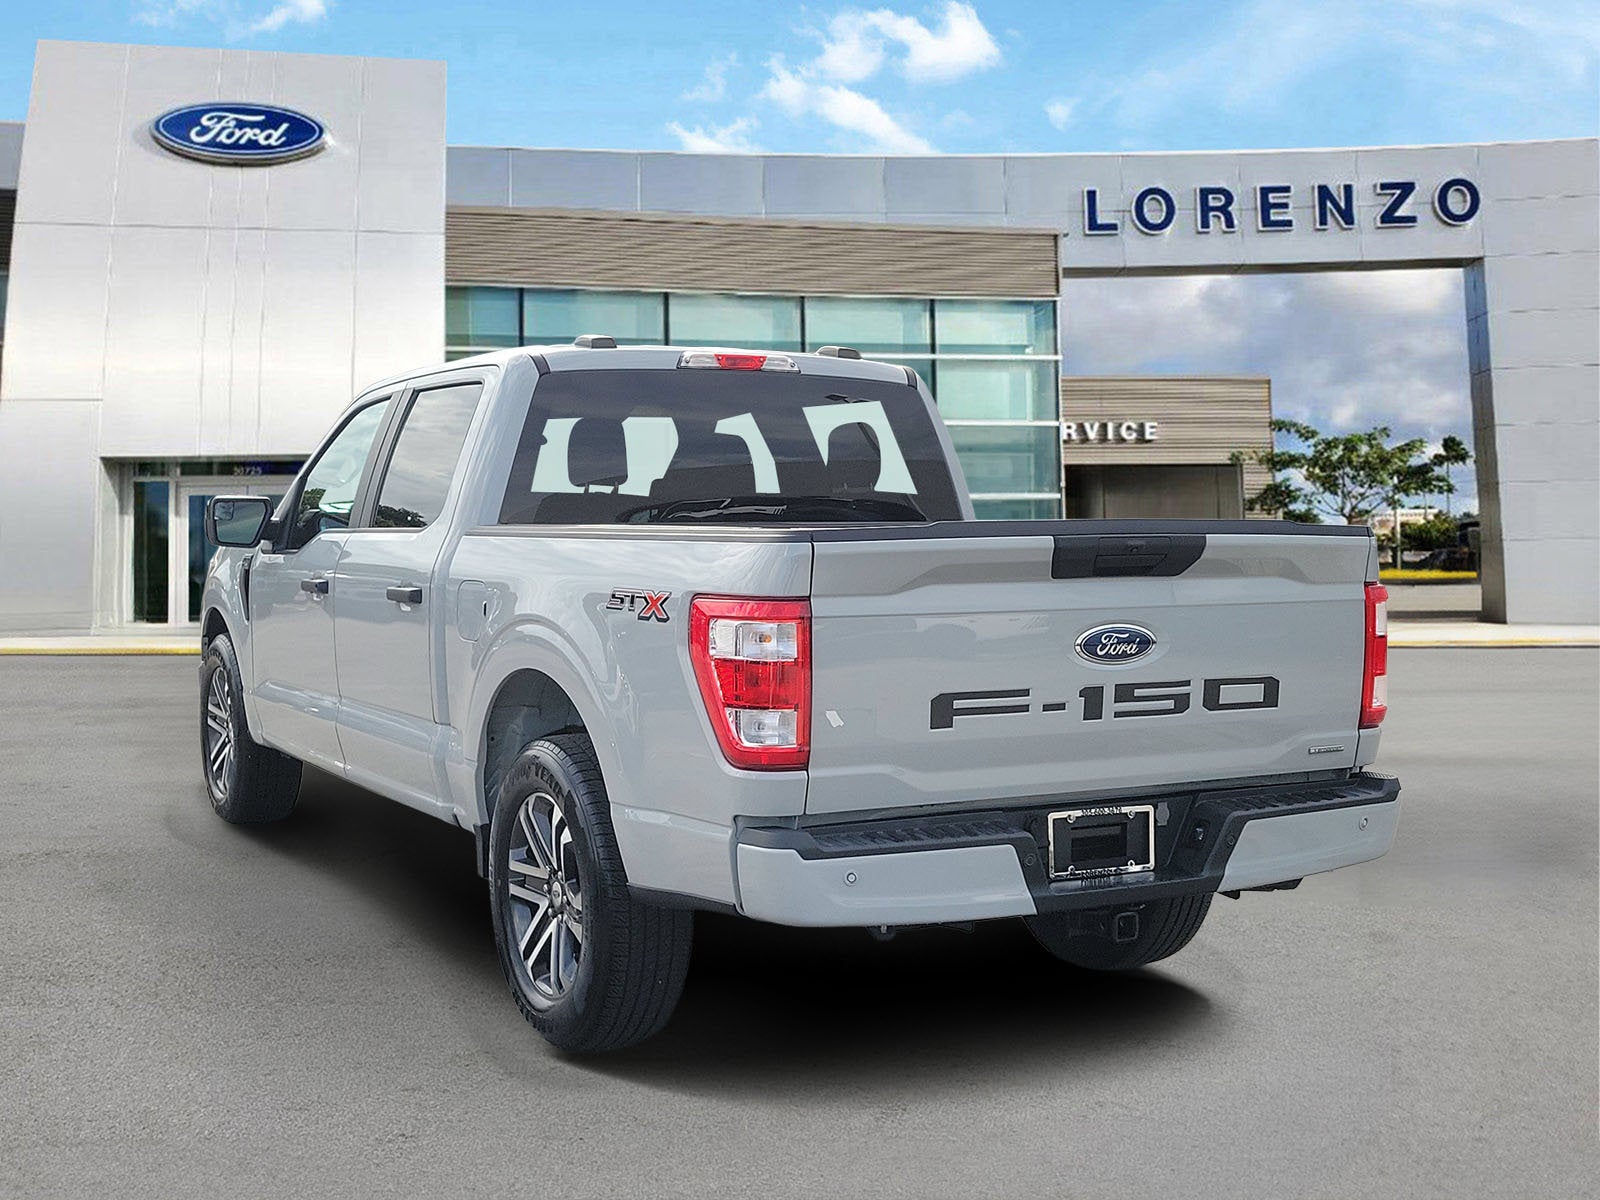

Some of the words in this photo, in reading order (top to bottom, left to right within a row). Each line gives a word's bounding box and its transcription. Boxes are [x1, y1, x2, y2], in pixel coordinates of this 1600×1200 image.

[189, 111, 290, 146] Ford
[1084, 178, 1480, 234] LORENZO
[605, 587, 672, 623] STX
[1096, 632, 1140, 656] Ford
[929, 675, 1281, 730] F-150
